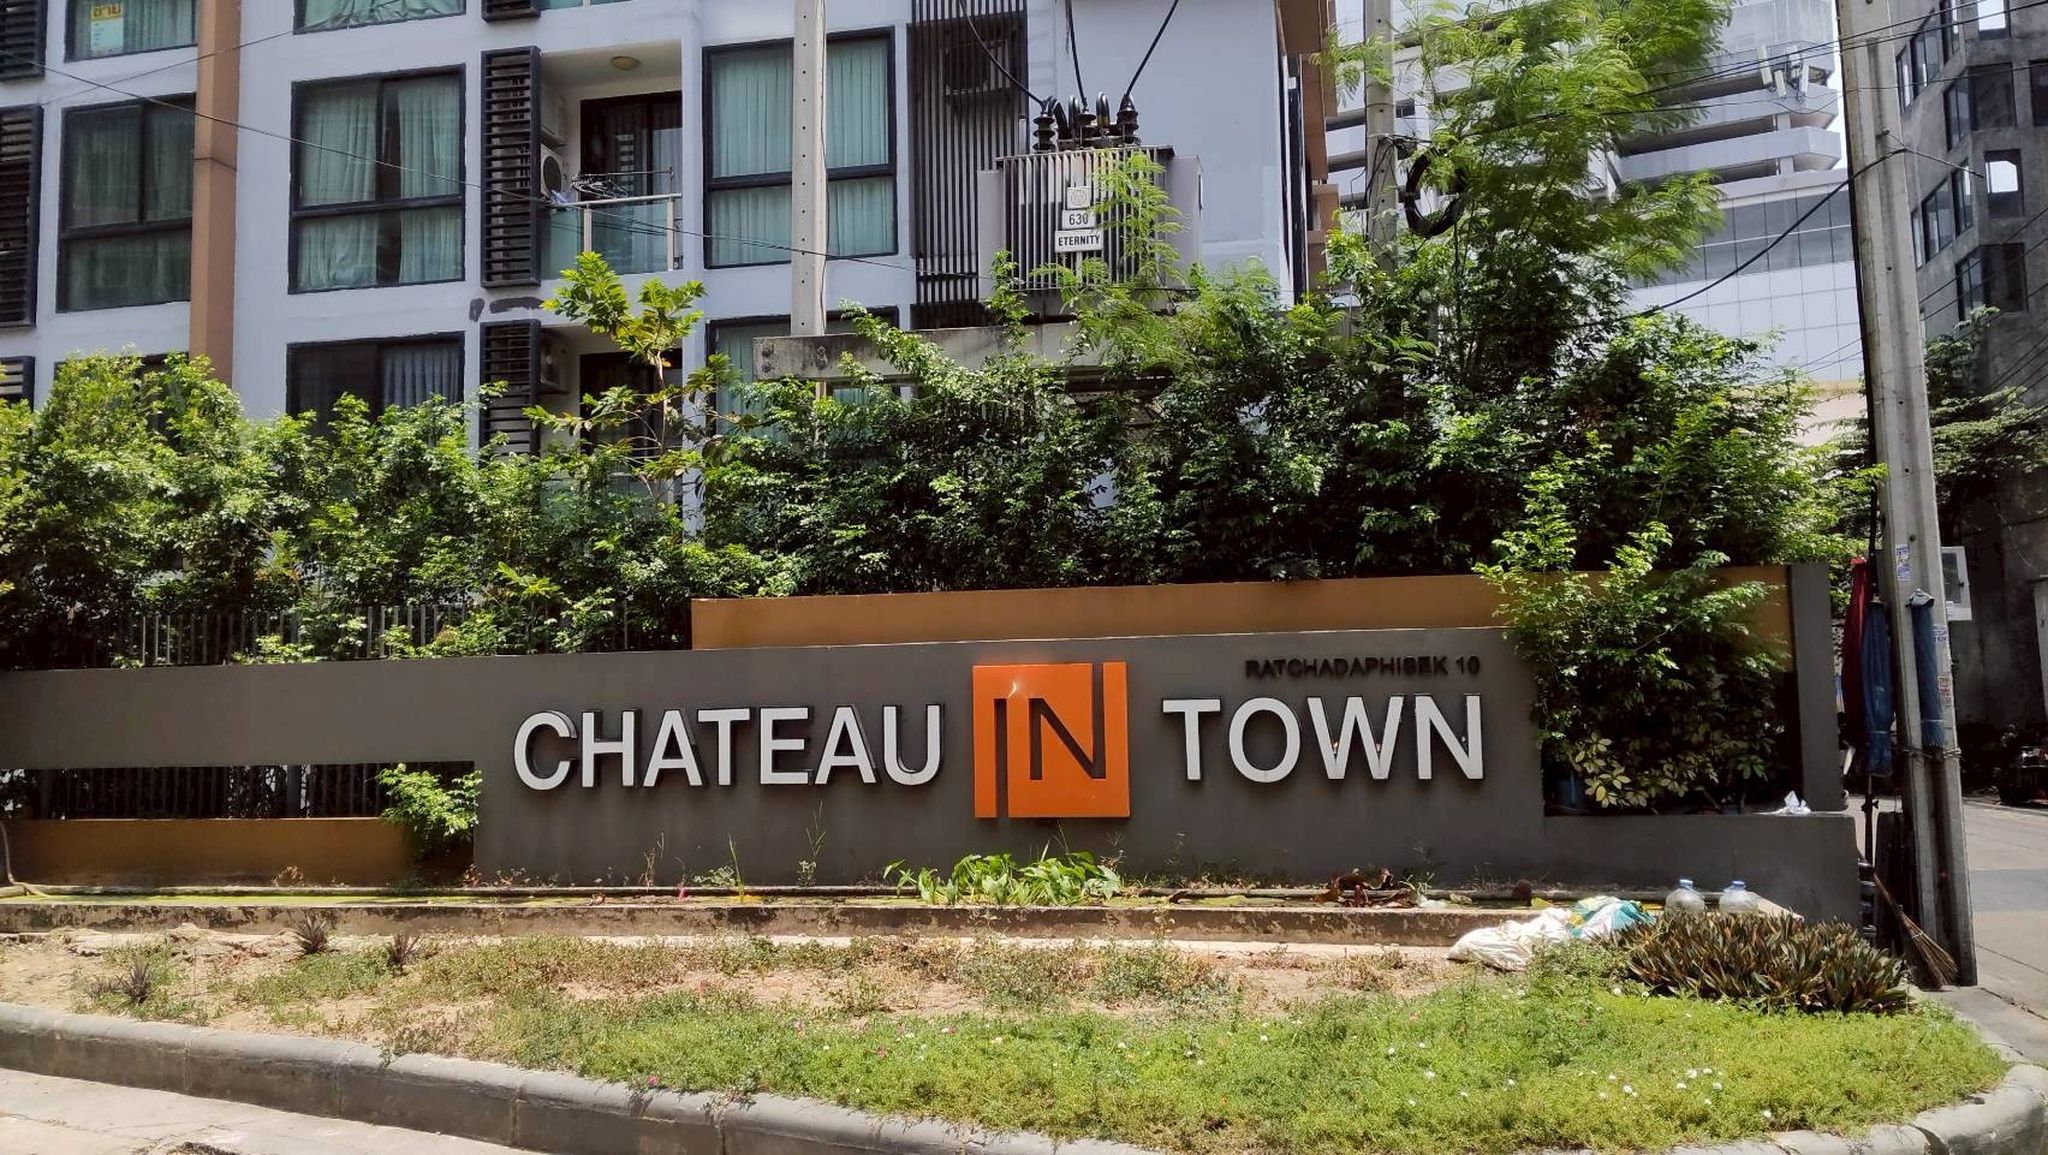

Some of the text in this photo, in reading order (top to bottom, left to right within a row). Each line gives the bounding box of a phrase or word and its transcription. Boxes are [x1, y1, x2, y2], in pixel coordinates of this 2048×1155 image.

[1069, 213, 1089, 225] 630
[1058, 235, 1100, 246] ETERNITY
[1245, 655, 1481, 679] RATCHADAPHISEK 10
[513, 663, 1485, 818] CHATEAU IN TOWN
